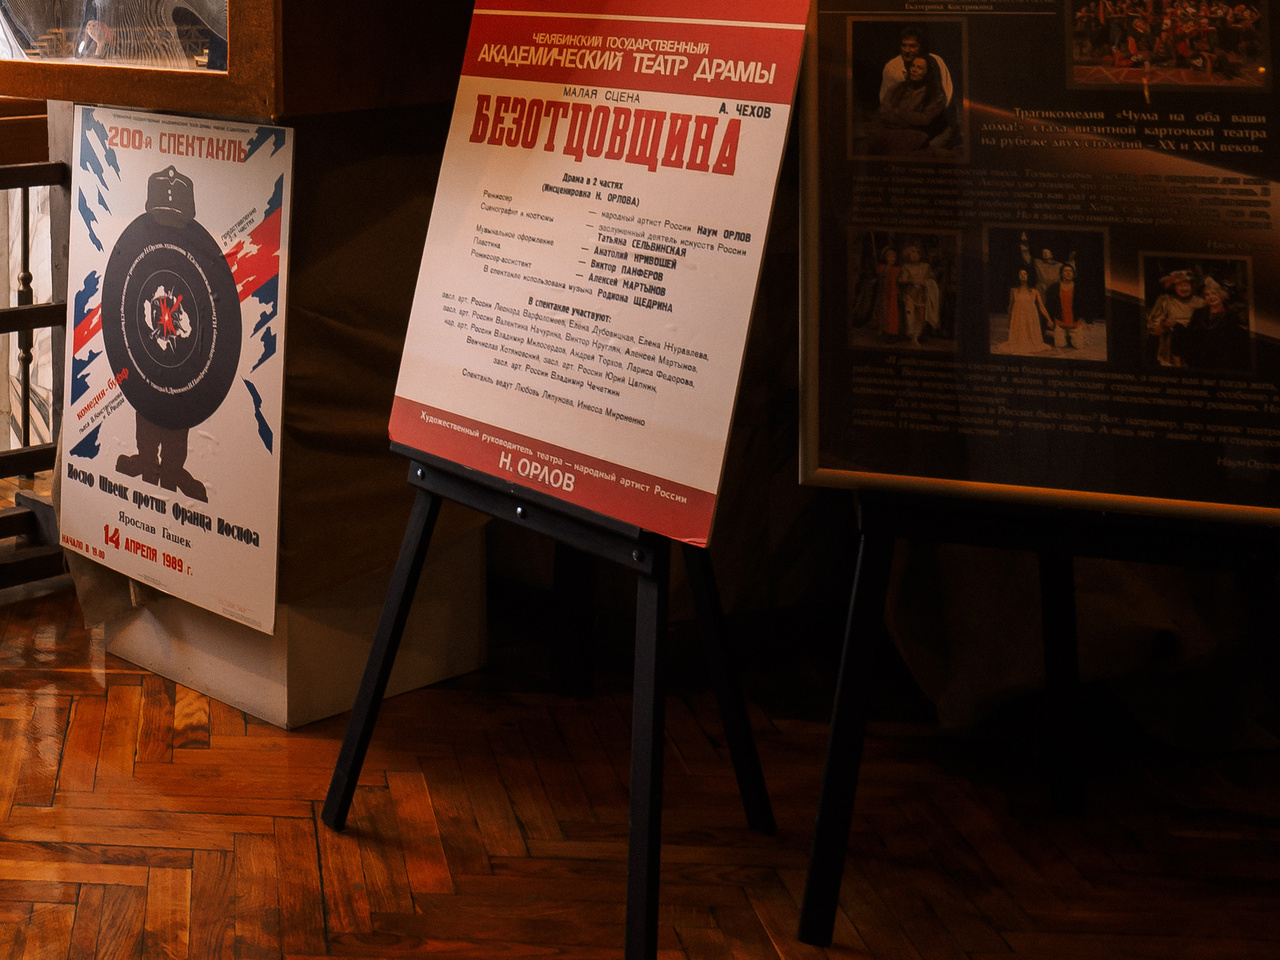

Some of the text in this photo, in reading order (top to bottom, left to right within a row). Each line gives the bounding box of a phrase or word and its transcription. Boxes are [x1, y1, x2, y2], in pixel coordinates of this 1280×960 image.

[532, 32, 710, 55] ЧЕЛЯБИНСКИЙ ГОСУДАРСТВЕННЫЙ
[477, 43, 777, 84] АКАДЕМИЧЕСКИЙ ТЕАТР ДРАМЫ
[562, 85, 640, 103] МАЛАЯ СЦЕНА
[718, 101, 772, 119] А. ЧЕХОВ
[1013, 107, 1104, 120] Трагикомедия
[1169, 113, 1185, 121] на
[1195, 111, 1220, 122] оба
[1231, 114, 1266, 123] ваши
[468, 93, 742, 176] БЕЗОТЦОВЩИНА
[1000, 137, 1047, 148] рубеже
[1053, 139, 1080, 147] двух
[1220, 144, 1263, 152] веков.
[1033, 124, 1067, 132] стала
[1074, 124, 1136, 135] визитной
[1144, 127, 1214, 138] карточкой
[1222, 128, 1268, 140] театра
[159, 131, 248, 163] СПЕКТАКЛЬ
[561, 172, 585, 184] Драма
[592, 177, 598, 186] 2
[599, 179, 623, 190] частях
[541, 183, 640, 208] (Инсценировка Н. ОРЛОВА)
[601, 211, 635, 222] народный
[636, 217, 662, 227] артист
[663, 218, 692, 232] России
[696, 225, 718, 237] Наум
[722, 229, 751, 243] ОРЛОВ
[597, 232, 687, 257] Татьяна СЕЛЬВИНСКАЯ
[646, 233, 678, 244] деятель
[679, 239, 715, 251] искусств
[717, 242, 747, 256] России
[590, 258, 617, 273] Виктор
[620, 264, 664, 282] ПАНФЕРОВ
[593, 245, 629, 260] Анатолий
[633, 253, 677, 270] КРИВОШЕЙ
[587, 272, 618, 286] Алексей
[622, 279, 666, 297] МАРТЫНОВ
[527, 296, 534, 305] В
[534, 299, 570, 314] спектакле
[597, 287, 629, 303] Родиона
[632, 296, 673, 313] ЩЕДРИНА
[568, 318, 590, 332] Елена
[637, 335, 661, 349] Елена
[564, 331, 590, 347] Виктор
[624, 347, 656, 362] Алексей
[524, 363, 549, 377] России
[569, 348, 595, 361] Андрей
[626, 361, 654, 377] Лариса
[577, 363, 603, 378] России
[604, 371, 626, 384] Юрий
[461, 367, 494, 384] Спектакль
[514, 382, 540, 397] Любовь
[576, 399, 603, 415] Инесса
[604, 407, 646, 427] Мироненко
[419, 409, 687, 504] Художественный руководитель театра народный артист России
[498, 450, 575, 492] Н. ОРЛОВ
[67, 462, 260, 548] Иосиф Швейк против Франца Иосифа
[61, 533, 83, 550] НАЧАЛО
[118, 510, 191, 549] Ярослав Гашек
[103, 523, 193, 576] 14 АПРЕЛЯ 1989 г.
